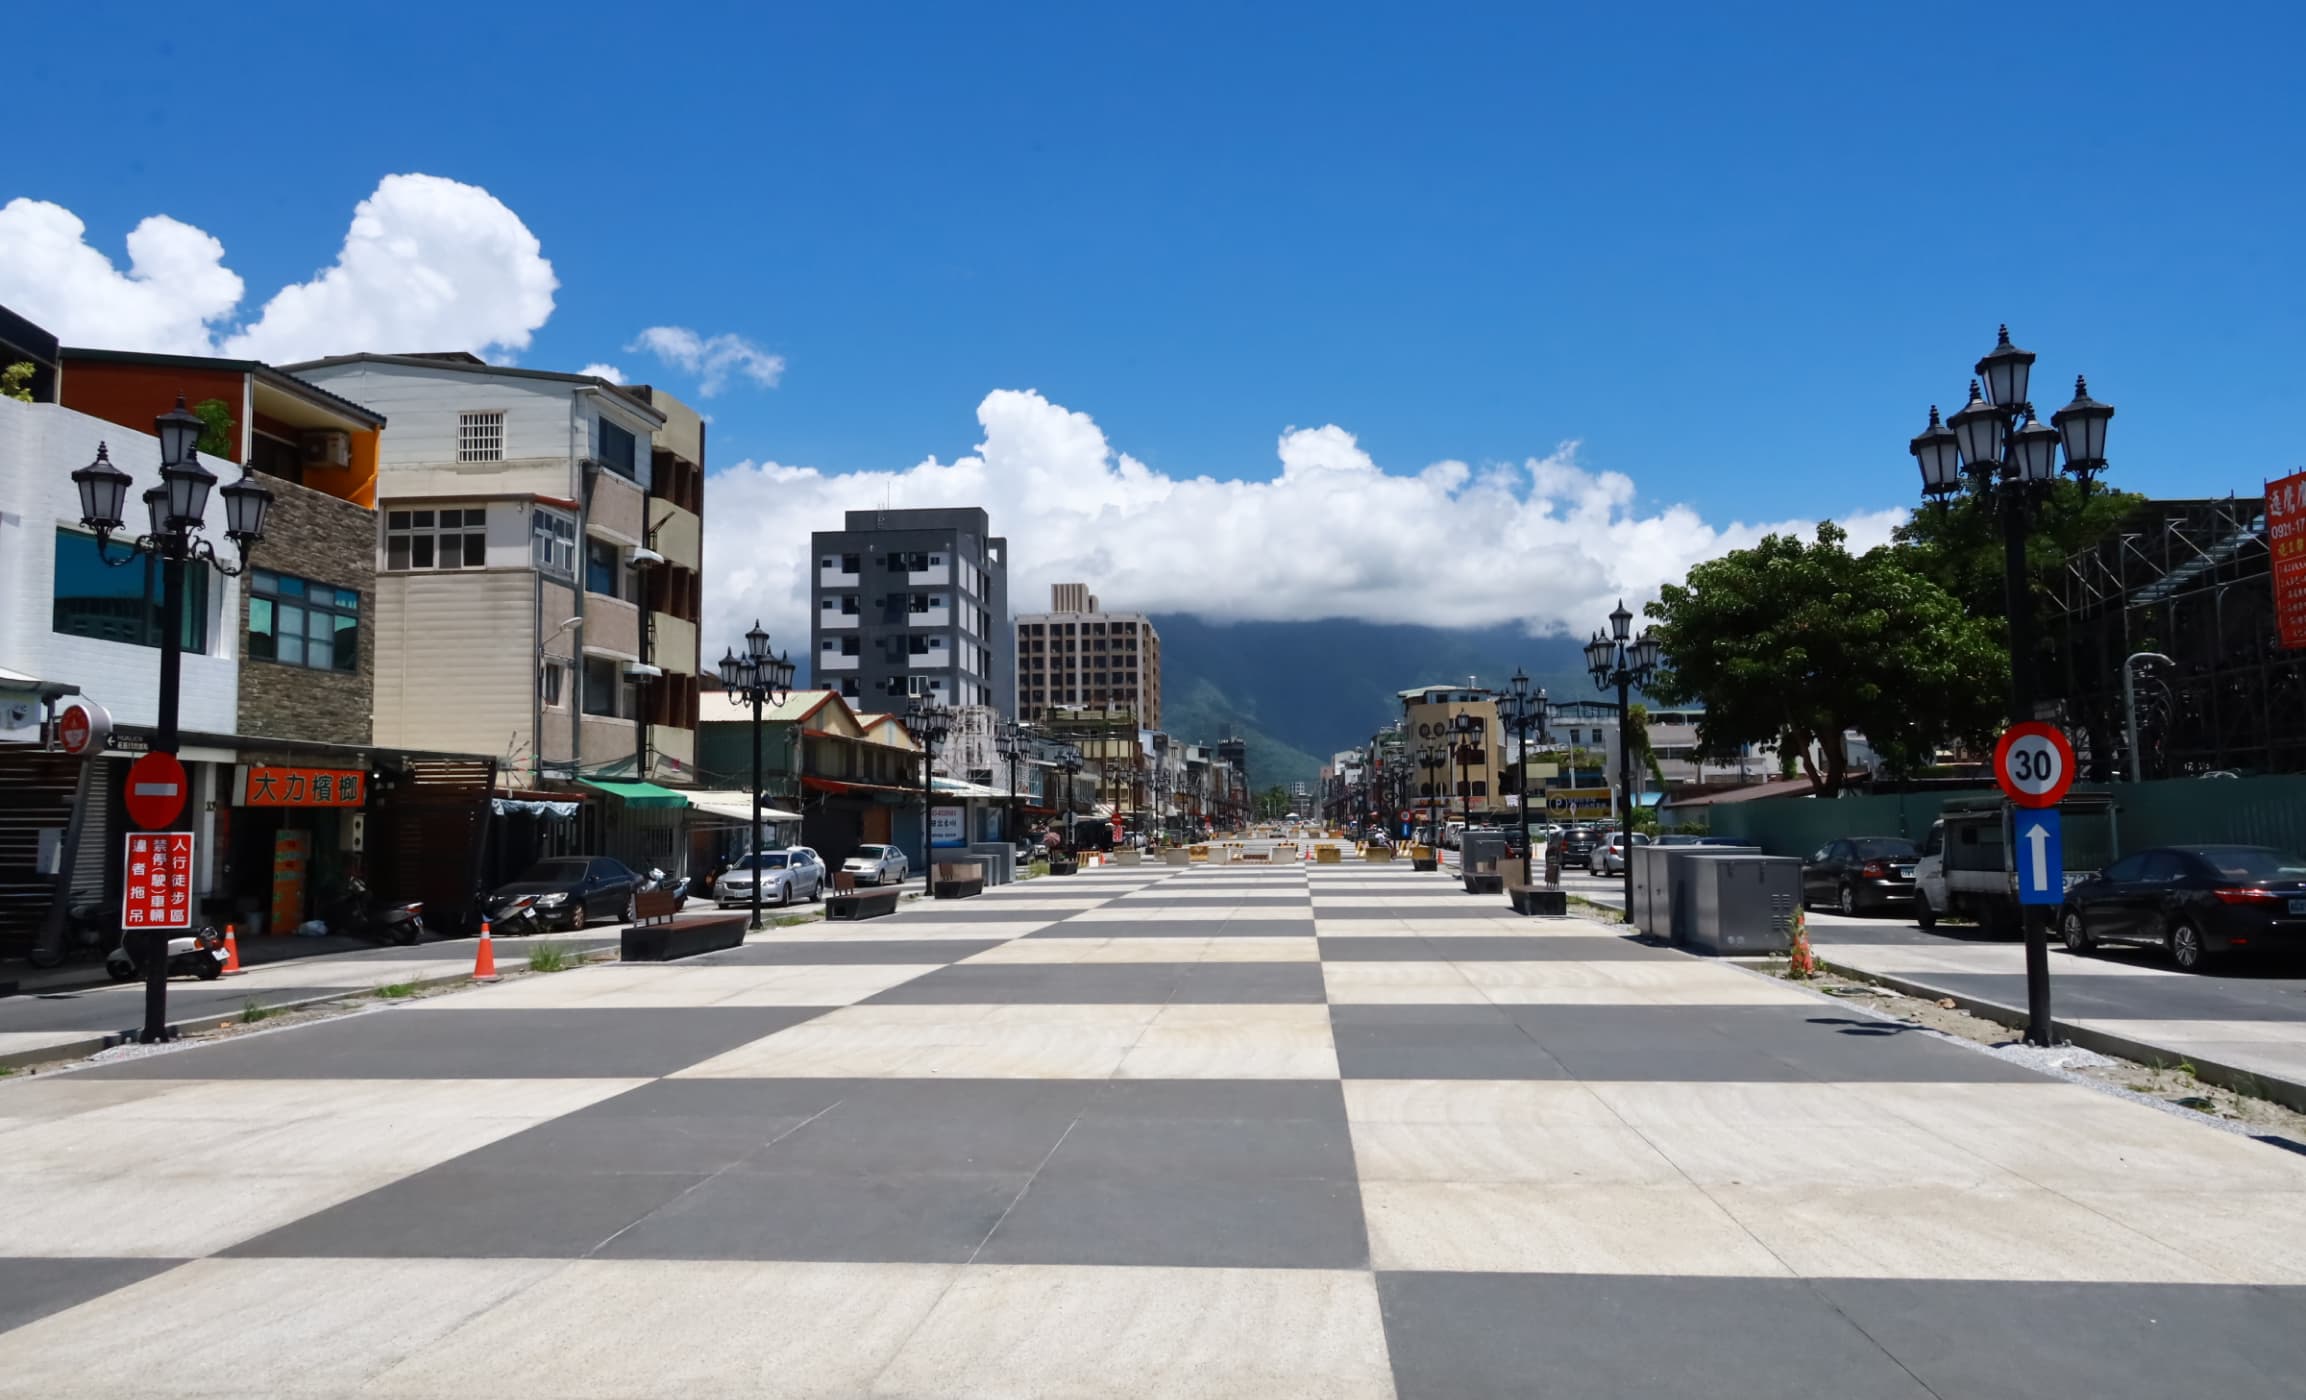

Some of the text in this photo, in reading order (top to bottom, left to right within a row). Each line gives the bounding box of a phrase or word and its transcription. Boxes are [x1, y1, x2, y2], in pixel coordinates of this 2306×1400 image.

[253, 771, 359, 802] 大力檳榔
[2015, 749, 2052, 781] 30
[129, 839, 147, 922] 違者拖吊
[170, 838, 187, 922] 人行徒步區
